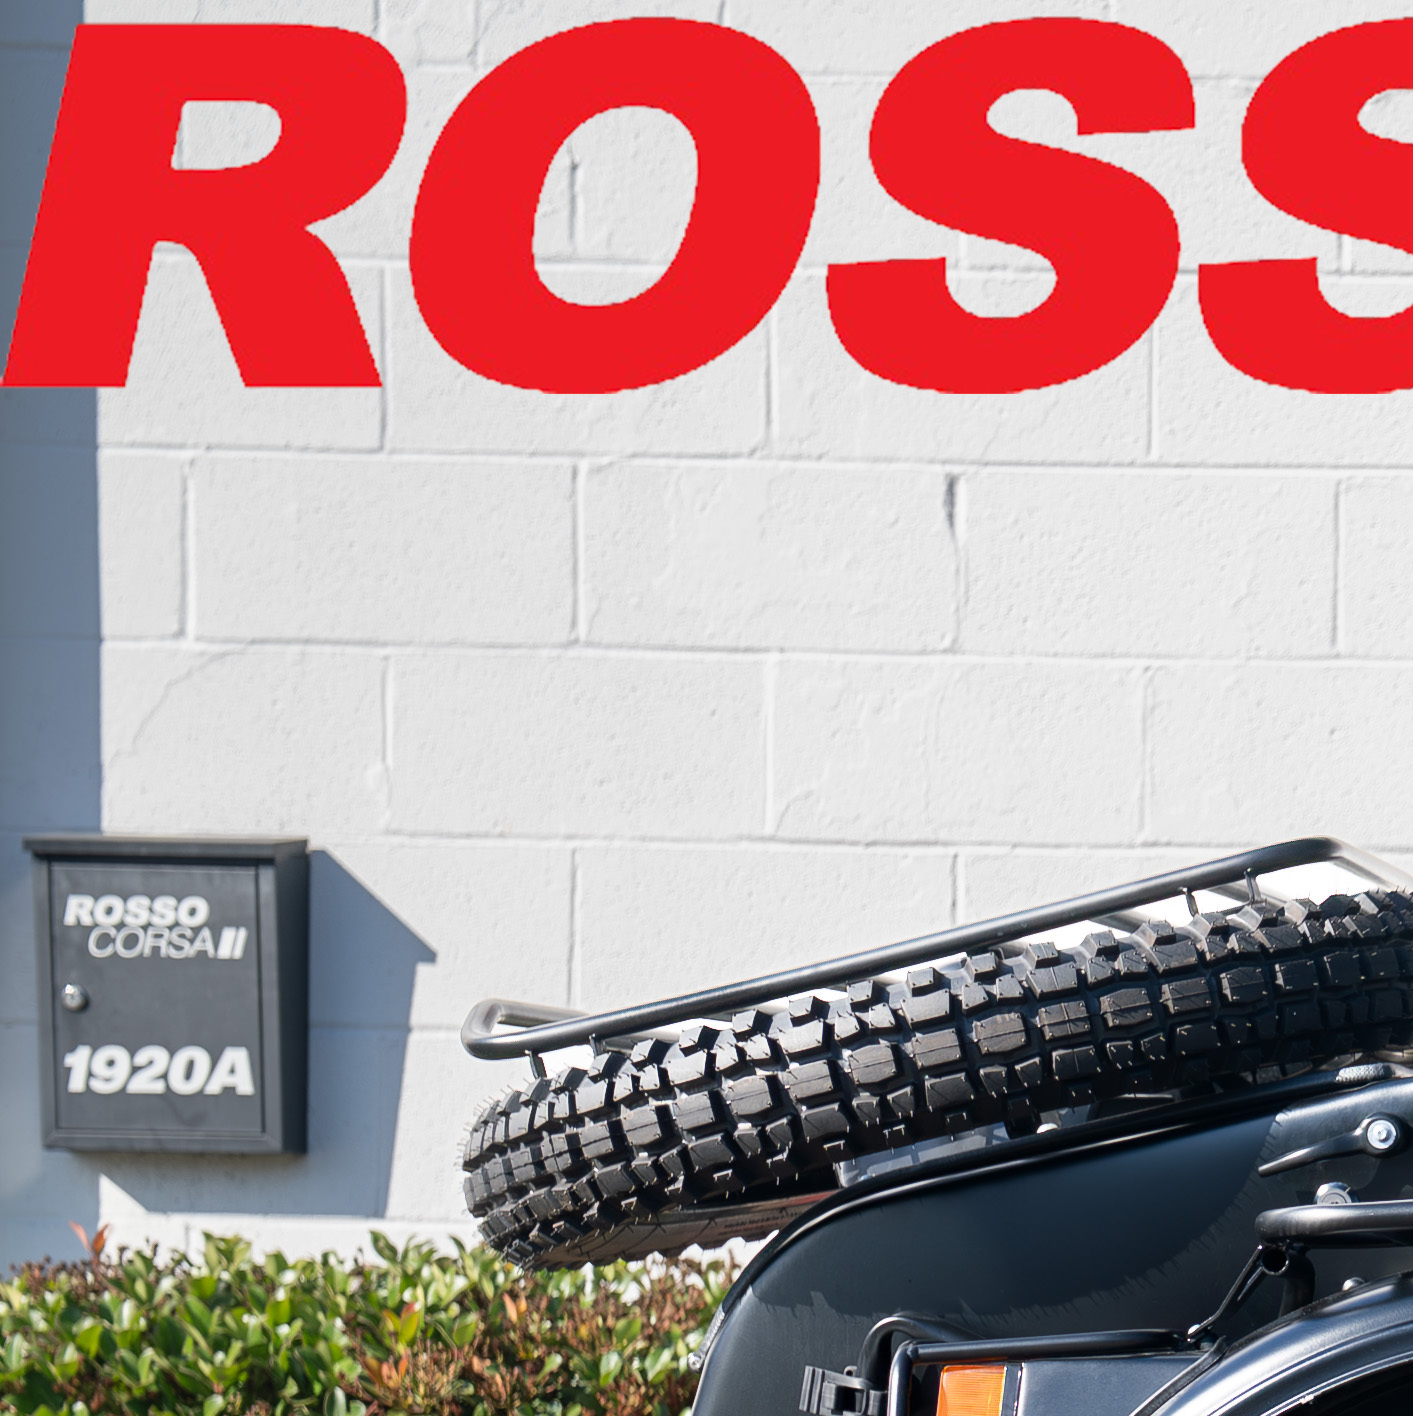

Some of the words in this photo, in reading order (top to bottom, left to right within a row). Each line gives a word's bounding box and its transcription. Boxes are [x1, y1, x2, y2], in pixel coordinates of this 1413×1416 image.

[63, 894, 210, 928] ROSSO
[87, 925, 217, 959] CORSA
[63, 1044, 256, 1096] 1920A
